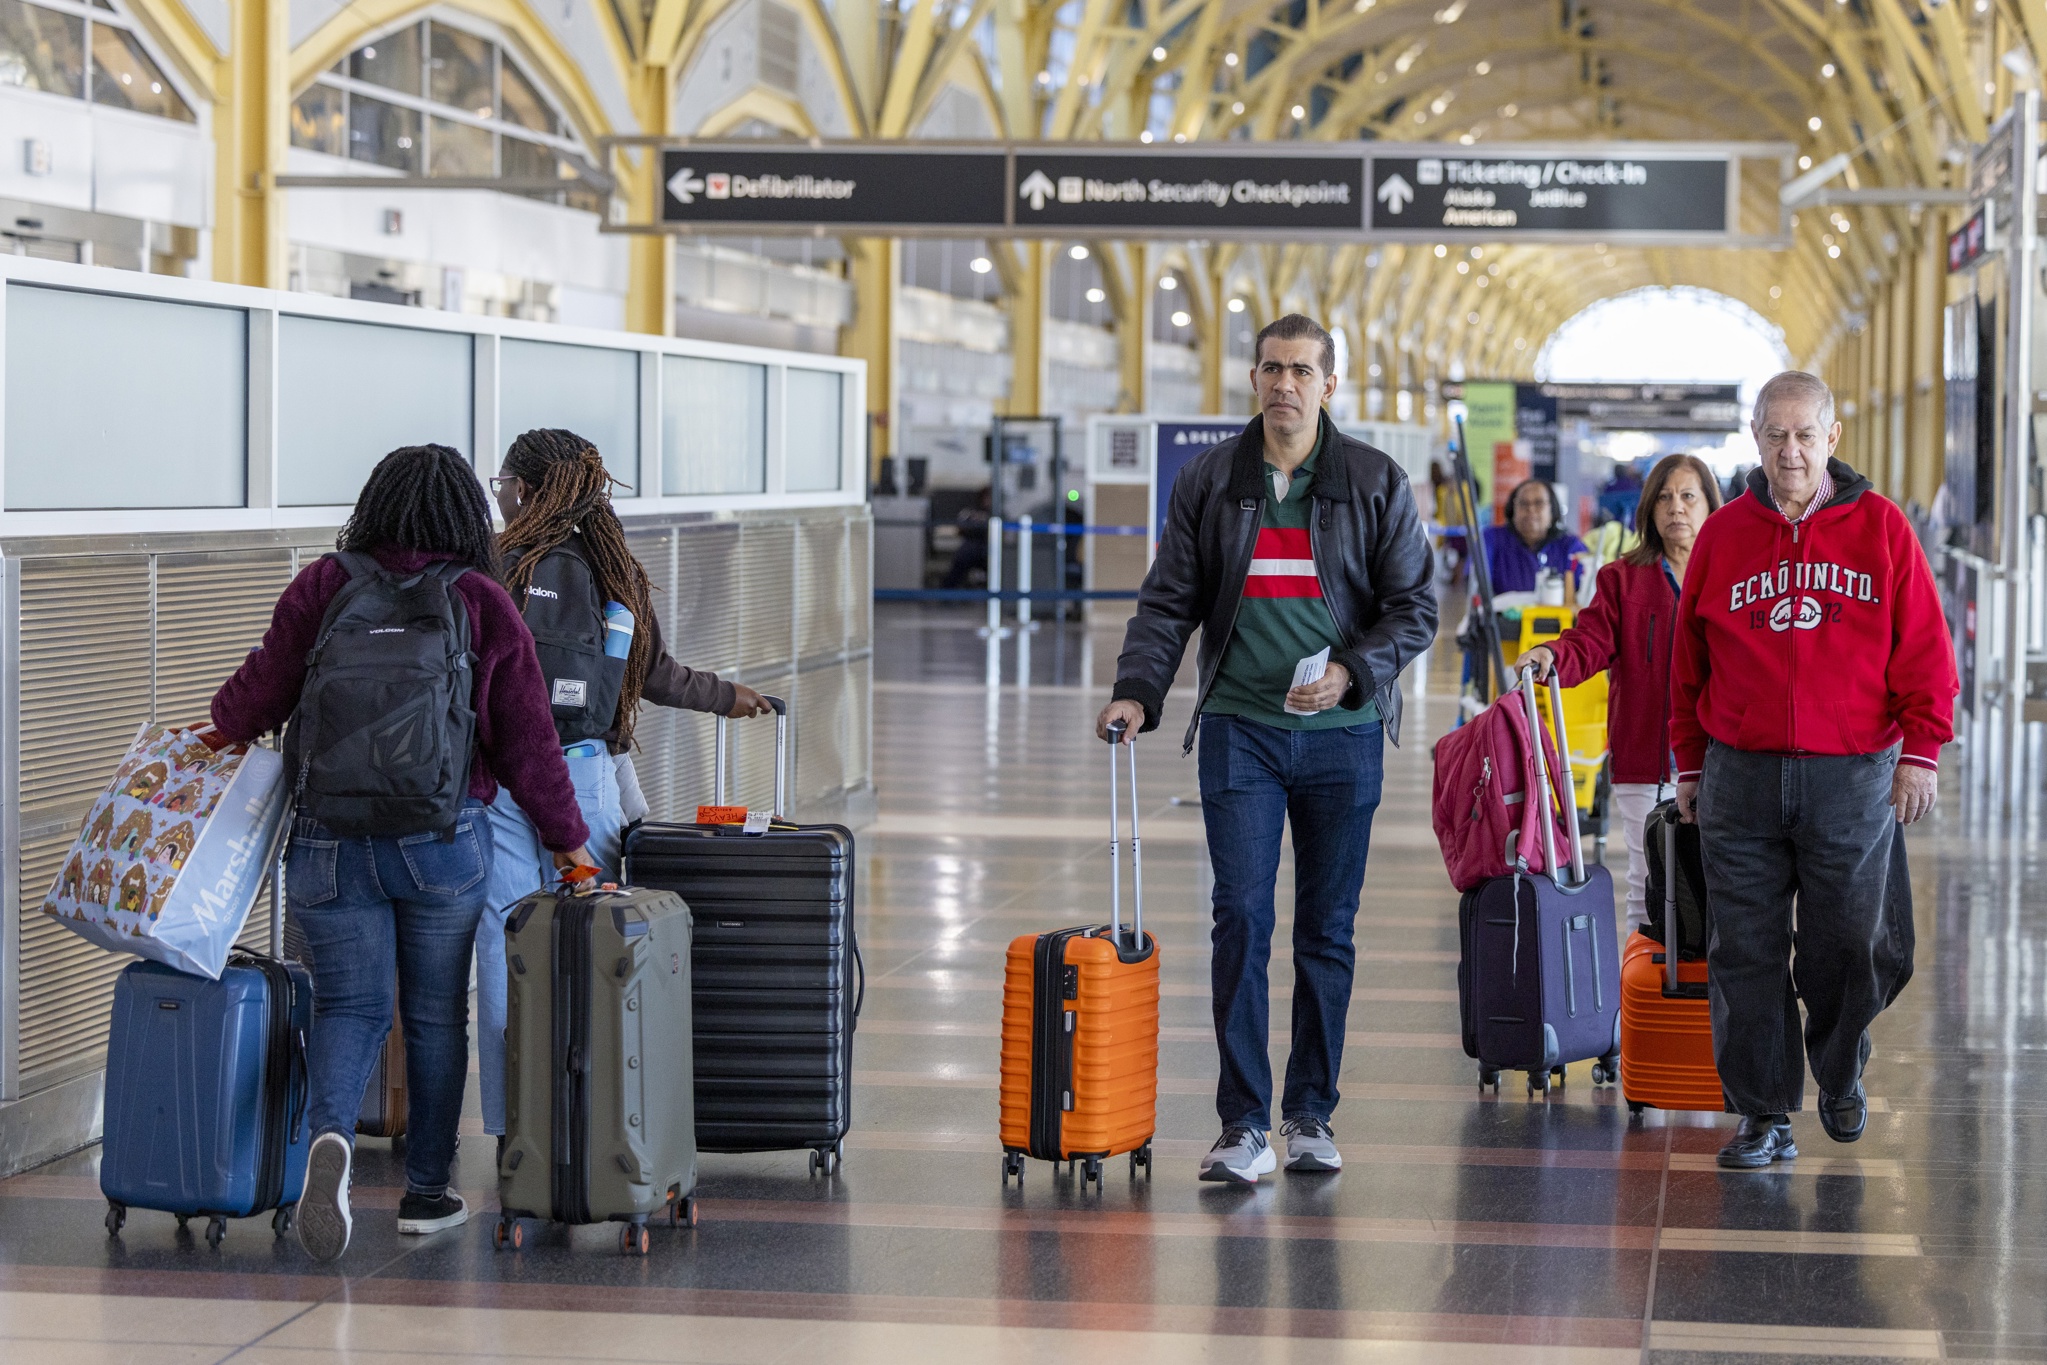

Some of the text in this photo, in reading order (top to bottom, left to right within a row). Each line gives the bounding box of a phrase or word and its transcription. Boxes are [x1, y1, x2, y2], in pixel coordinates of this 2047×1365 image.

[731, 174, 856, 199] Defibrillator
[1085, 178, 1350, 208] North Security Checkpoint
[1750, 610, 1766, 630] 19
[707, 813, 738, 823] HEAVY
[192, 789, 276, 937] Marshalls
[223, 896, 240, 926] Shop
